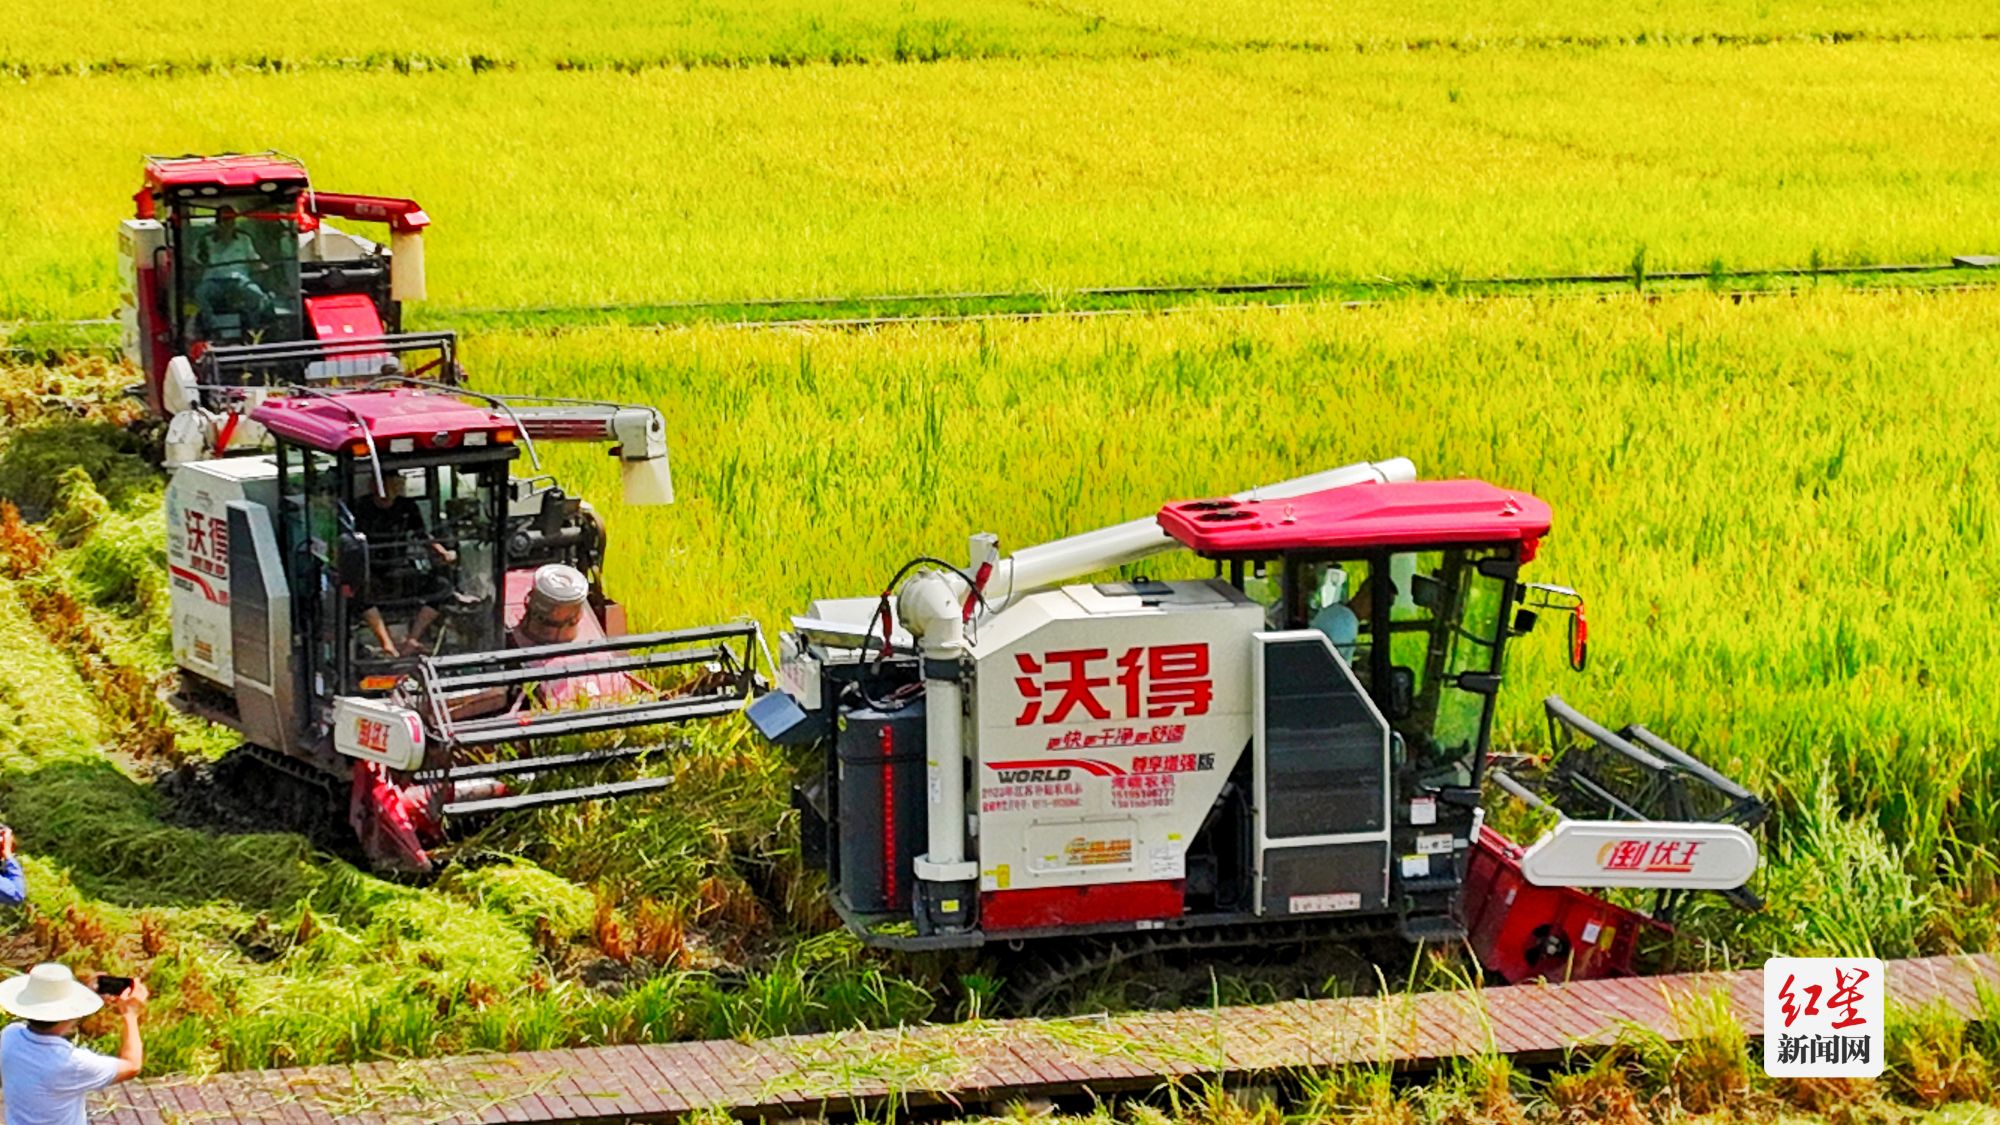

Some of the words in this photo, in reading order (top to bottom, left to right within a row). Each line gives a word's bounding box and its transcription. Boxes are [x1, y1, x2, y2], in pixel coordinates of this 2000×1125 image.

[1015, 643, 1213, 726] 沃得
[998, 769, 1072, 784] WORLD
[1606, 841, 1706, 870] 倒伏王
